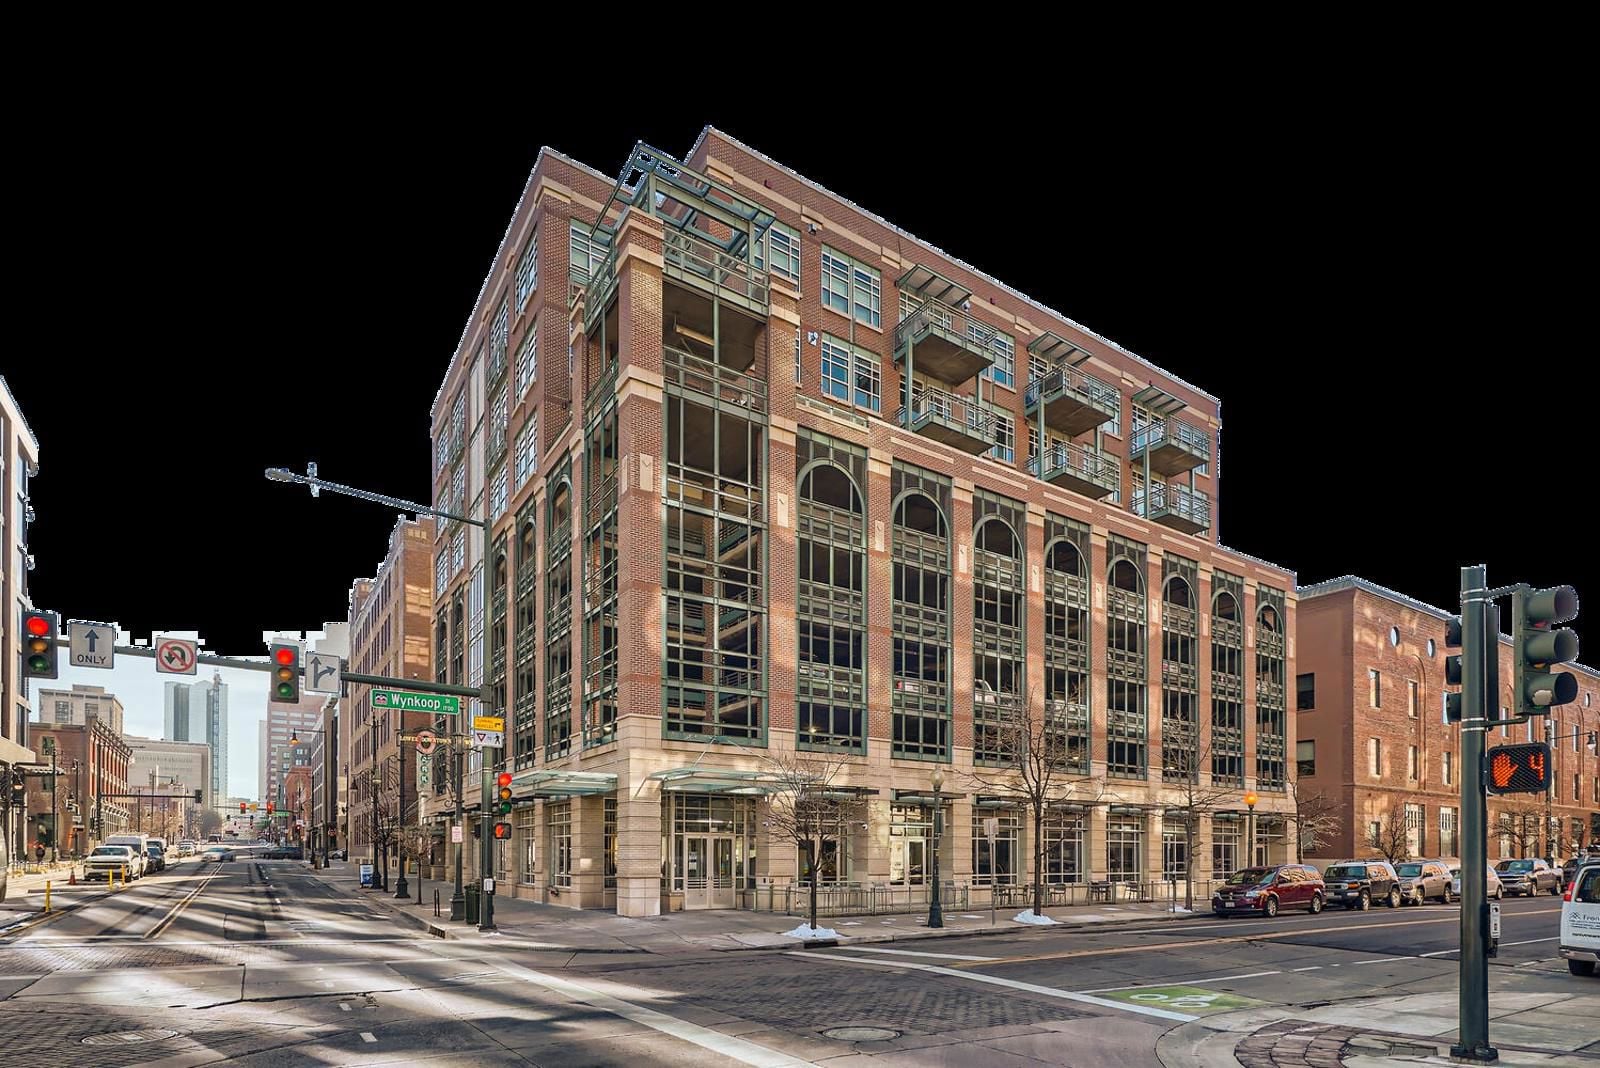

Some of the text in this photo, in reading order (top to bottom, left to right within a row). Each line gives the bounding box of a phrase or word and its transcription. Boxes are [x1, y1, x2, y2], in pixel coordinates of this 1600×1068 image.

[77, 654, 106, 665] ONLY
[391, 693, 441, 710] Wynkoop
[1528, 752, 1545, 782] 4
